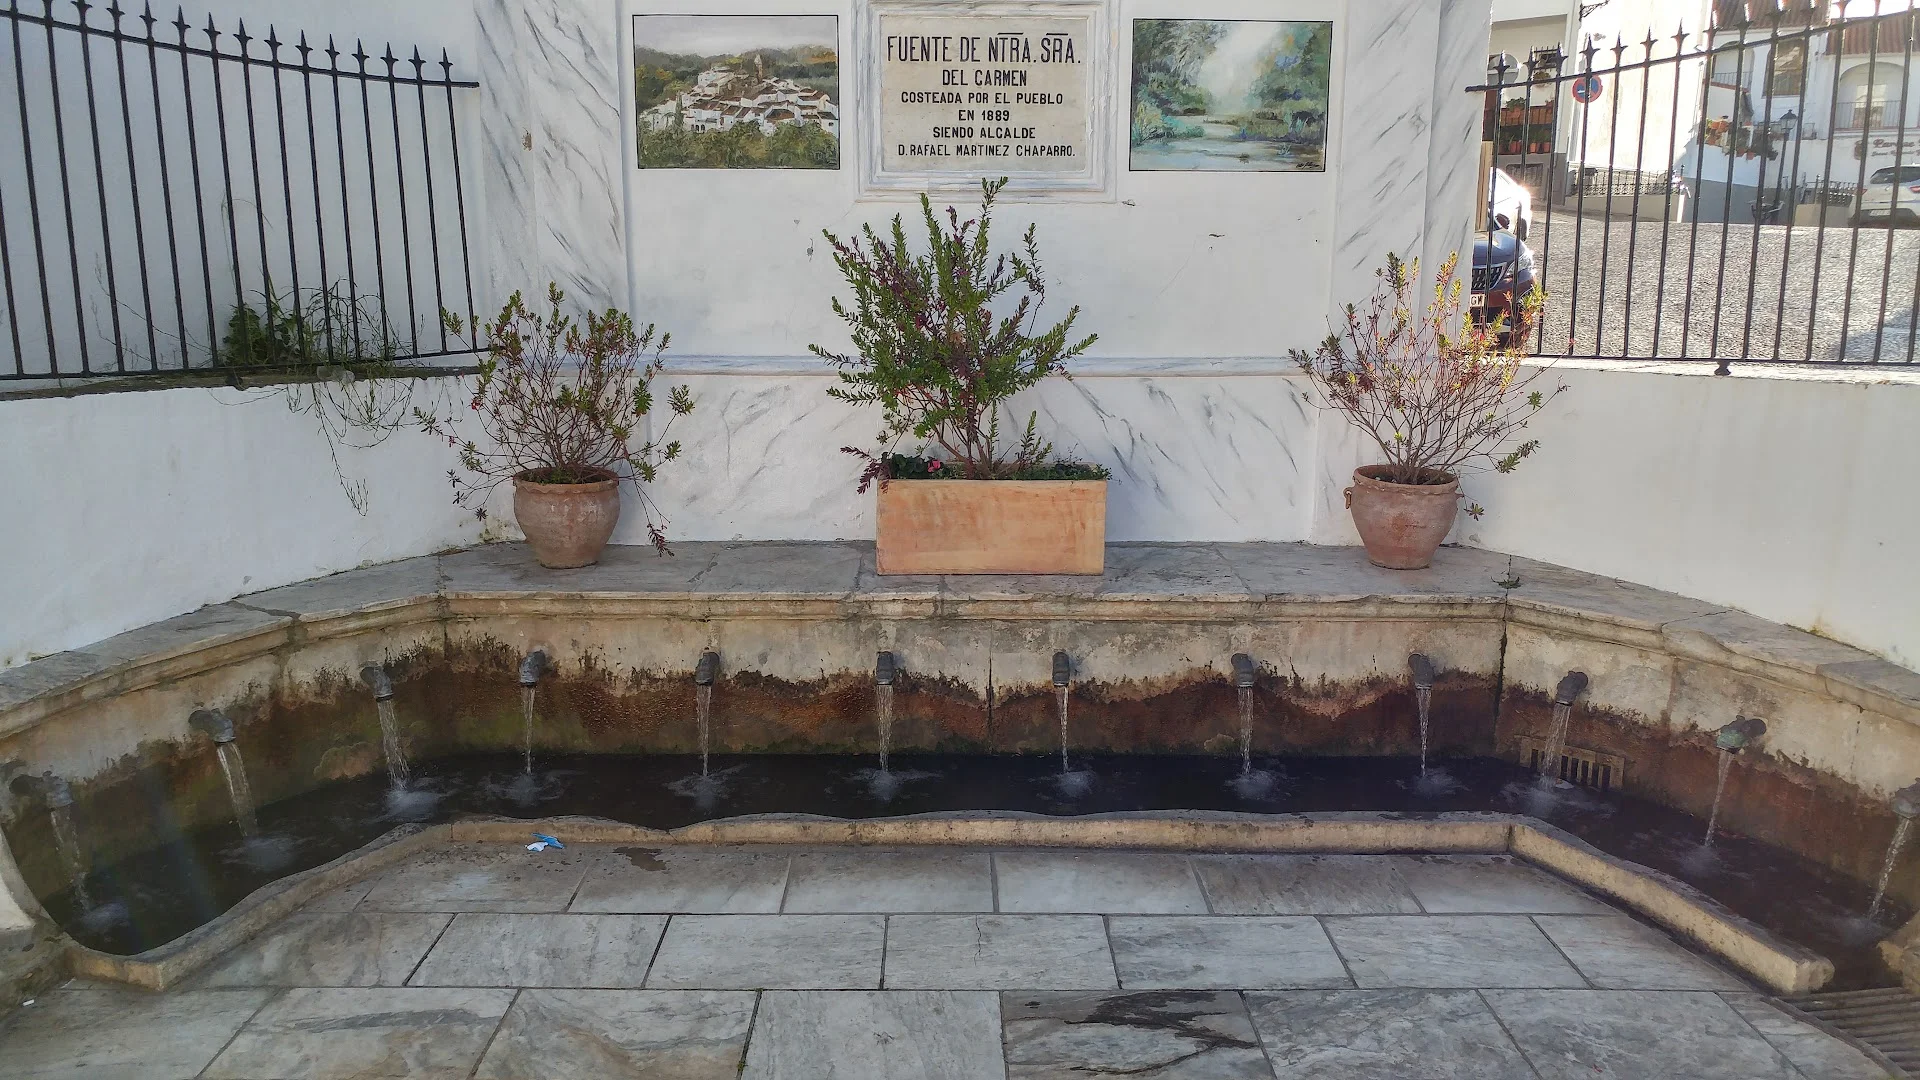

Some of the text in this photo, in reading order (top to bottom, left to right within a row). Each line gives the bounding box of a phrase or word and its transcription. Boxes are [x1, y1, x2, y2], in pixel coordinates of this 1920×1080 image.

[887, 36, 952, 62] FUENTE
[960, 36, 981, 63] DE
[942, 69, 1027, 87] DEL CARMEN
[901, 91, 1063, 105] COSTEADA POR EL PUEBLO
[958, 109, 1010, 122] EN 1889
[932, 126, 1036, 139] SIENDO ALCALDE
[955, 144, 1010, 157] MARTINEZ
[1015, 144, 1076, 157] CHAPARRO.
